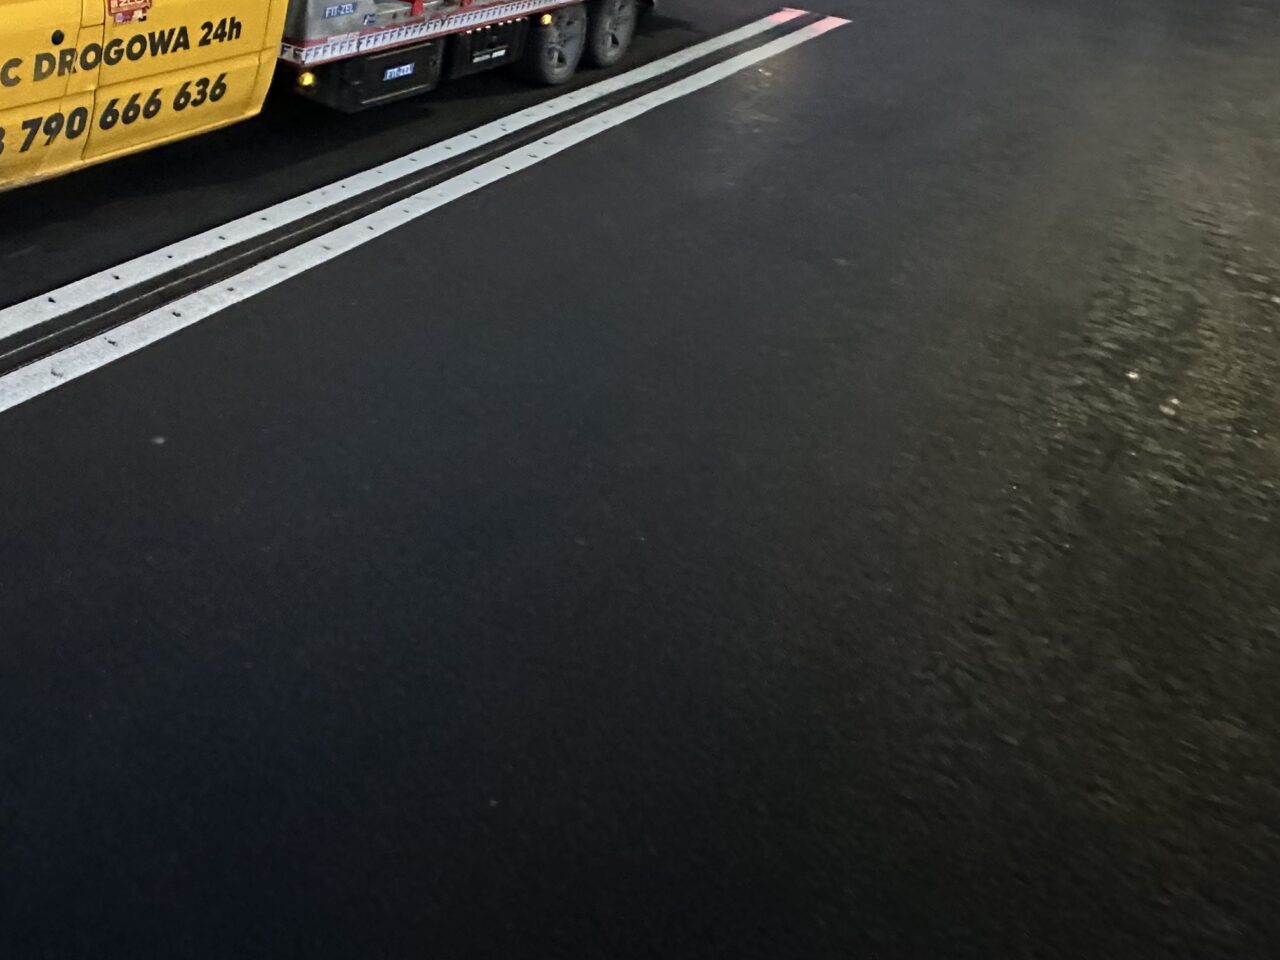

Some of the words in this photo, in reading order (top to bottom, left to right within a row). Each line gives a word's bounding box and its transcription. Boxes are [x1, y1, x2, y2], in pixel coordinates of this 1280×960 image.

[33, 26, 190, 82] DROGOWA
[198, 16, 242, 48] 24h
[19, 106, 89, 153] 790
[98, 88, 163, 131] 666
[172, 73, 227, 111] 636
